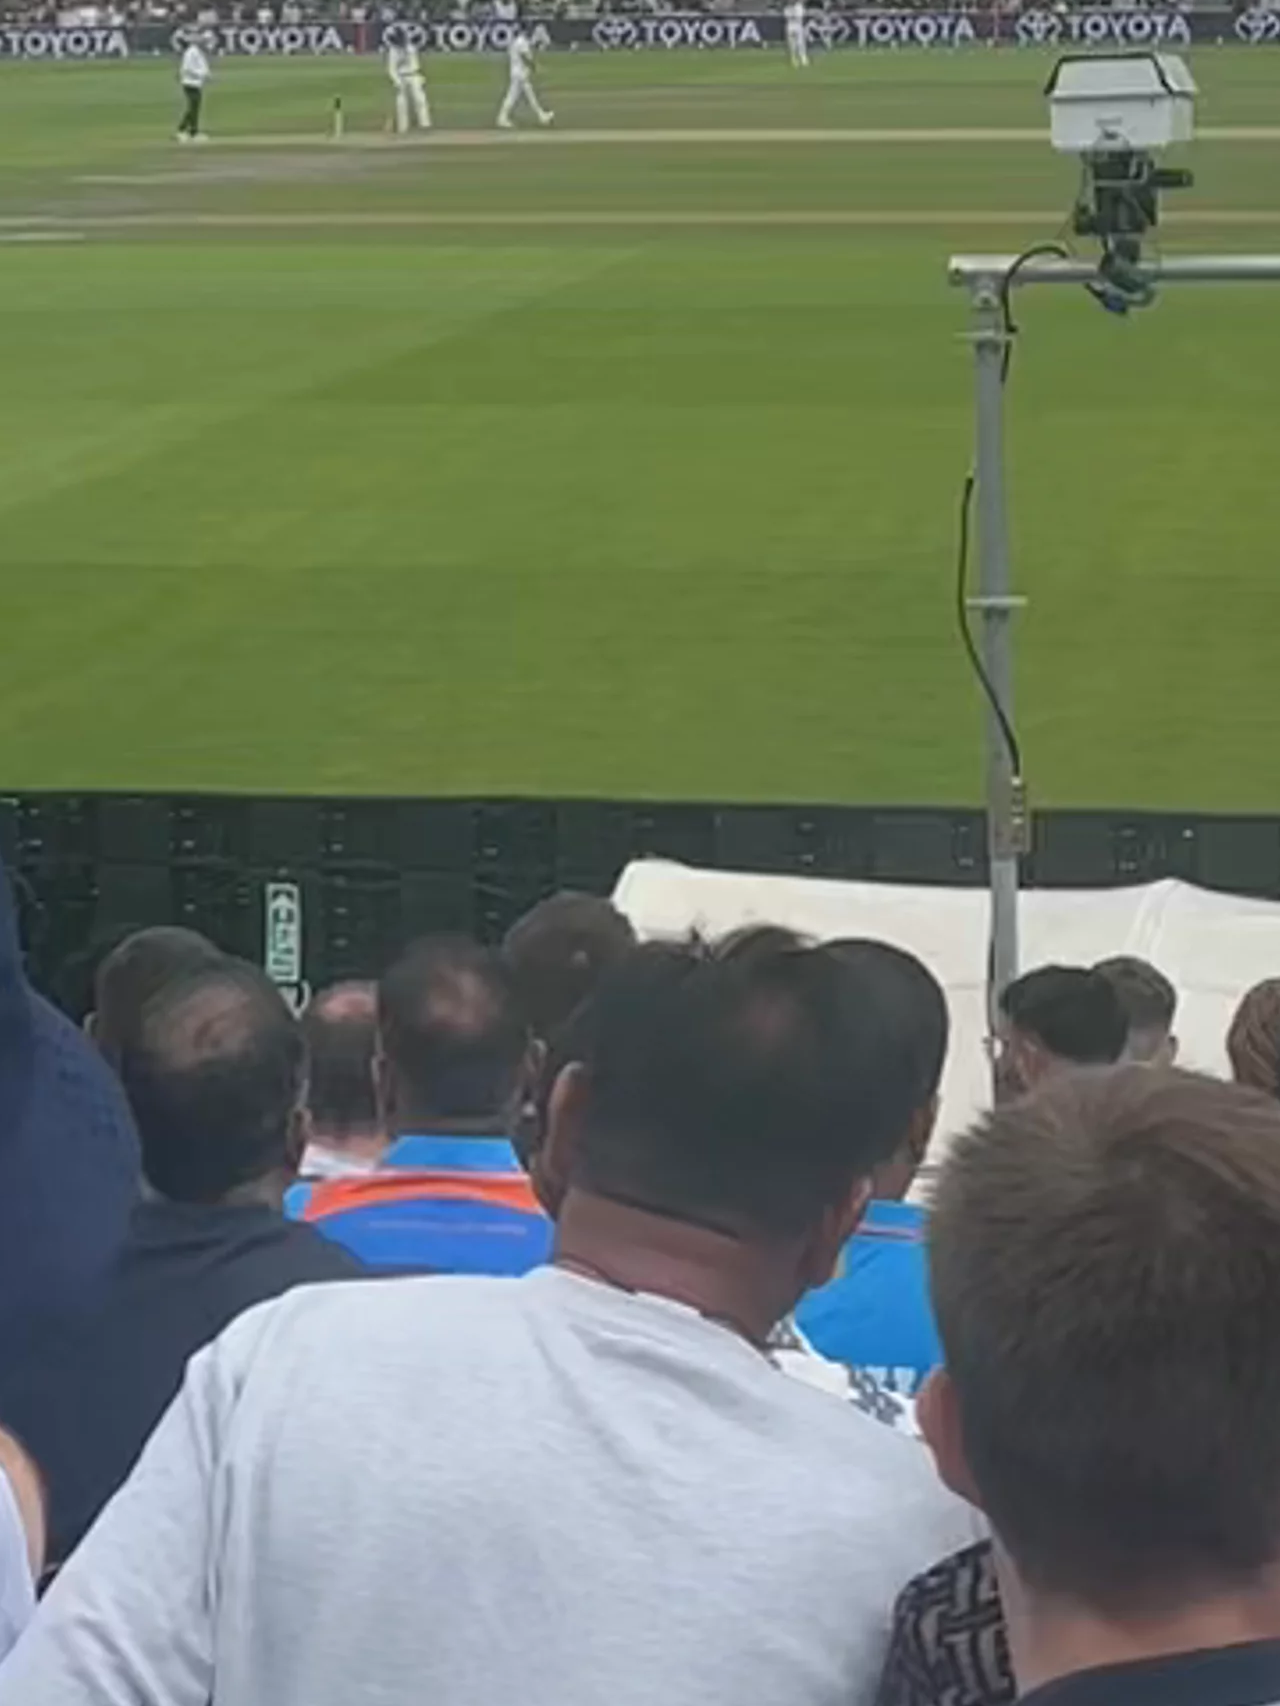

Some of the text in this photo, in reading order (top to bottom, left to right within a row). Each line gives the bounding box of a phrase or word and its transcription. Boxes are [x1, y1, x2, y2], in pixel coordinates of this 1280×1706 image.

[222, 26, 342, 52] TOYOTA
[641, 19, 761, 45] TOYOTA
[853, 16, 975, 42] TOYOTA
[1067, 14, 1190, 41] TOYOTA
[6, 30, 129, 56] TOYOTA
